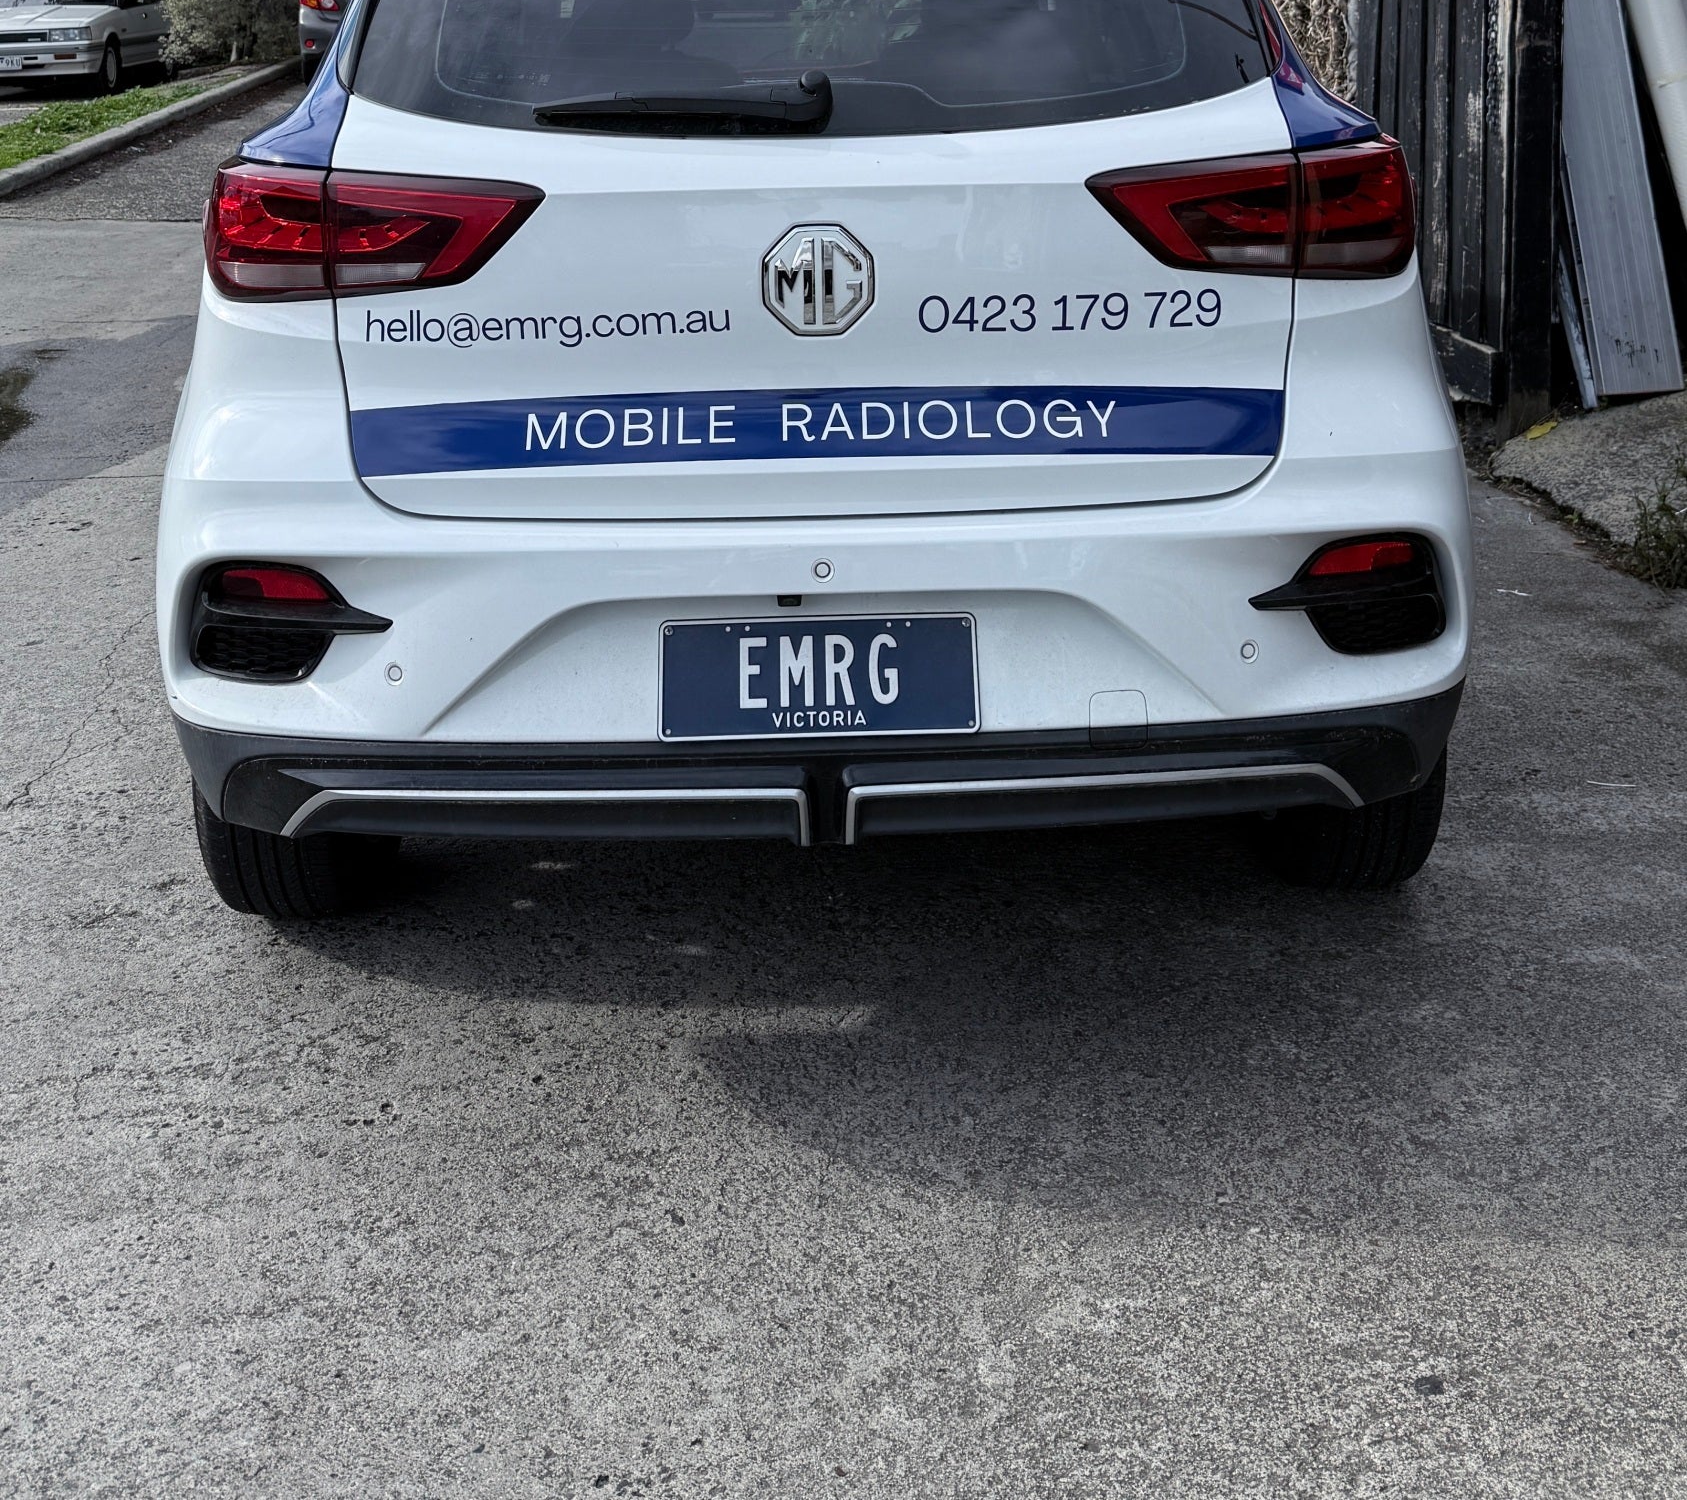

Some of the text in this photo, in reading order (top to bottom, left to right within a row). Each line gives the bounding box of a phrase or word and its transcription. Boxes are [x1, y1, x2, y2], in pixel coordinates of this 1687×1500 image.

[774, 237, 863, 325] MG
[365, 309, 731, 348] hello@emrg.com.au
[917, 288, 1222, 334] 0423 179 729
[525, 400, 1116, 451] MOBILE RADIOLOGY
[739, 633, 899, 709] EMRG
[772, 710, 867, 728] VICTORIA
